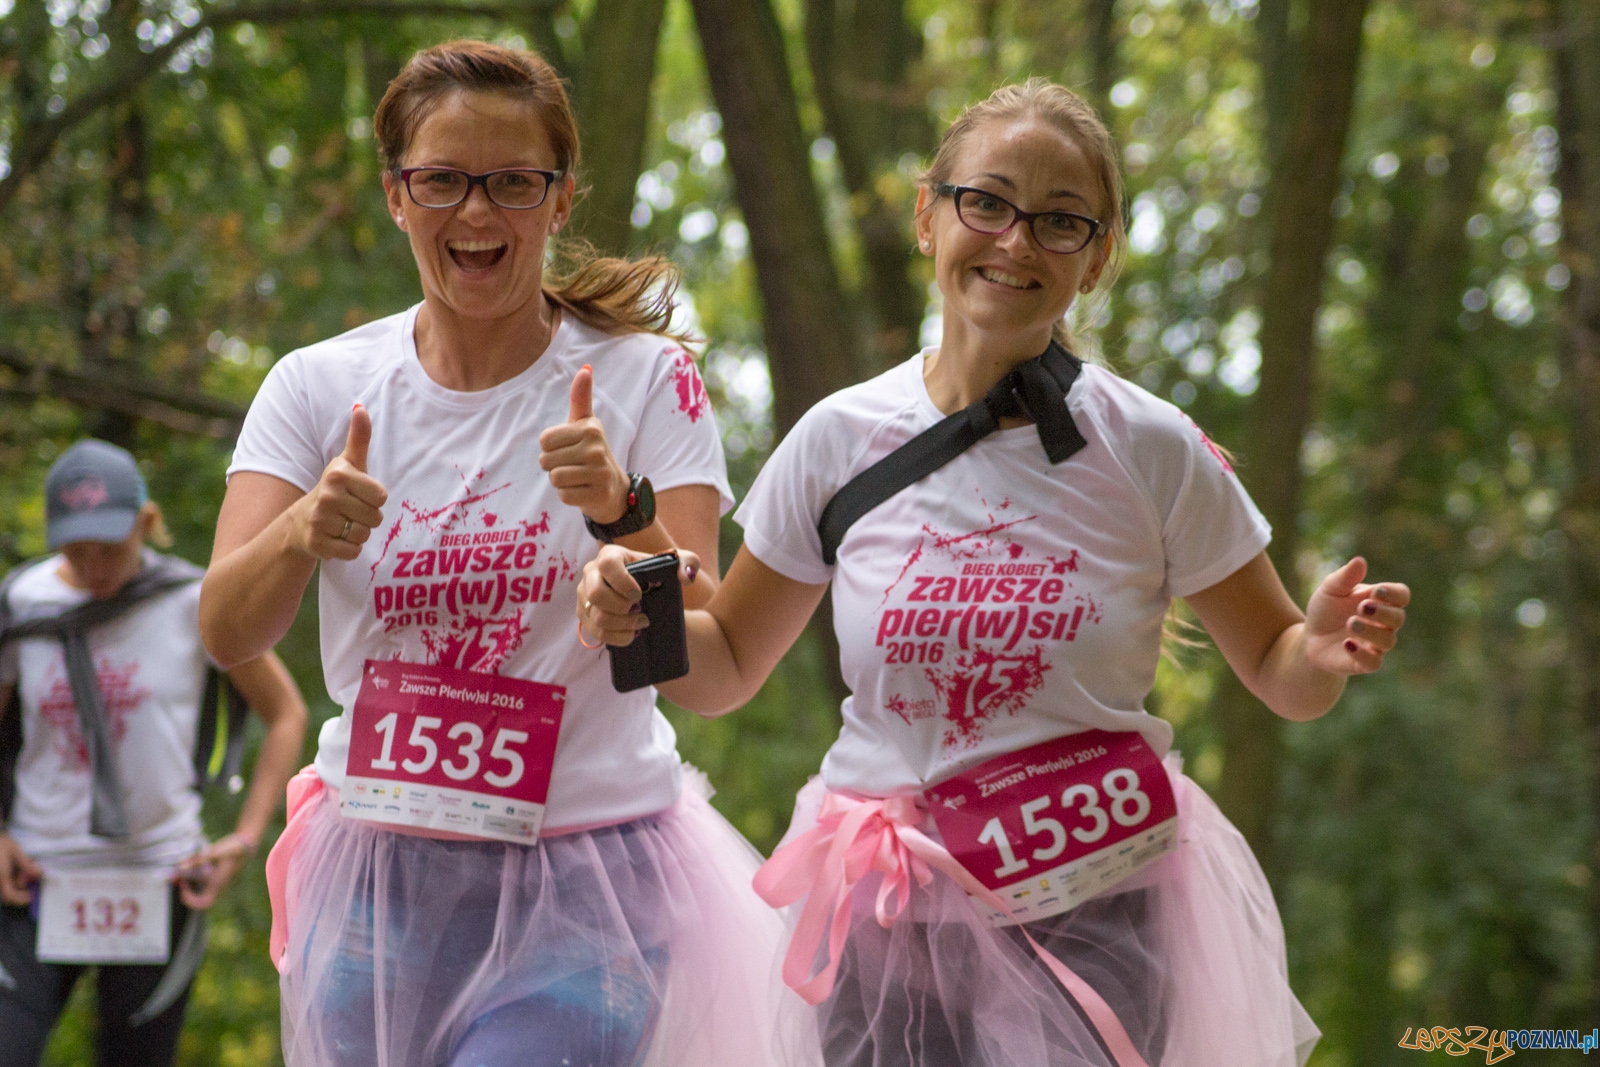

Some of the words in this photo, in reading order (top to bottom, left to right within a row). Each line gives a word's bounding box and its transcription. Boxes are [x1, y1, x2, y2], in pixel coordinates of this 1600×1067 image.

[440, 533, 470, 547] BIEG
[472, 529, 520, 545] KOBIET
[392, 541, 537, 579] zawsze
[962, 563, 994, 575] BIEG
[996, 563, 1048, 576] KOBIET
[906, 575, 1064, 604] zawsze
[383, 611, 438, 633] 2016
[885, 641, 944, 664] 2016
[399, 680, 437, 697] Zawsze
[491, 693, 525, 710] 2016
[370, 711, 529, 788] 1535
[978, 770, 1026, 798] Zawsze
[1074, 745, 1108, 763] 2016
[977, 768, 1151, 879] 1538
[70, 896, 141, 935] 132
